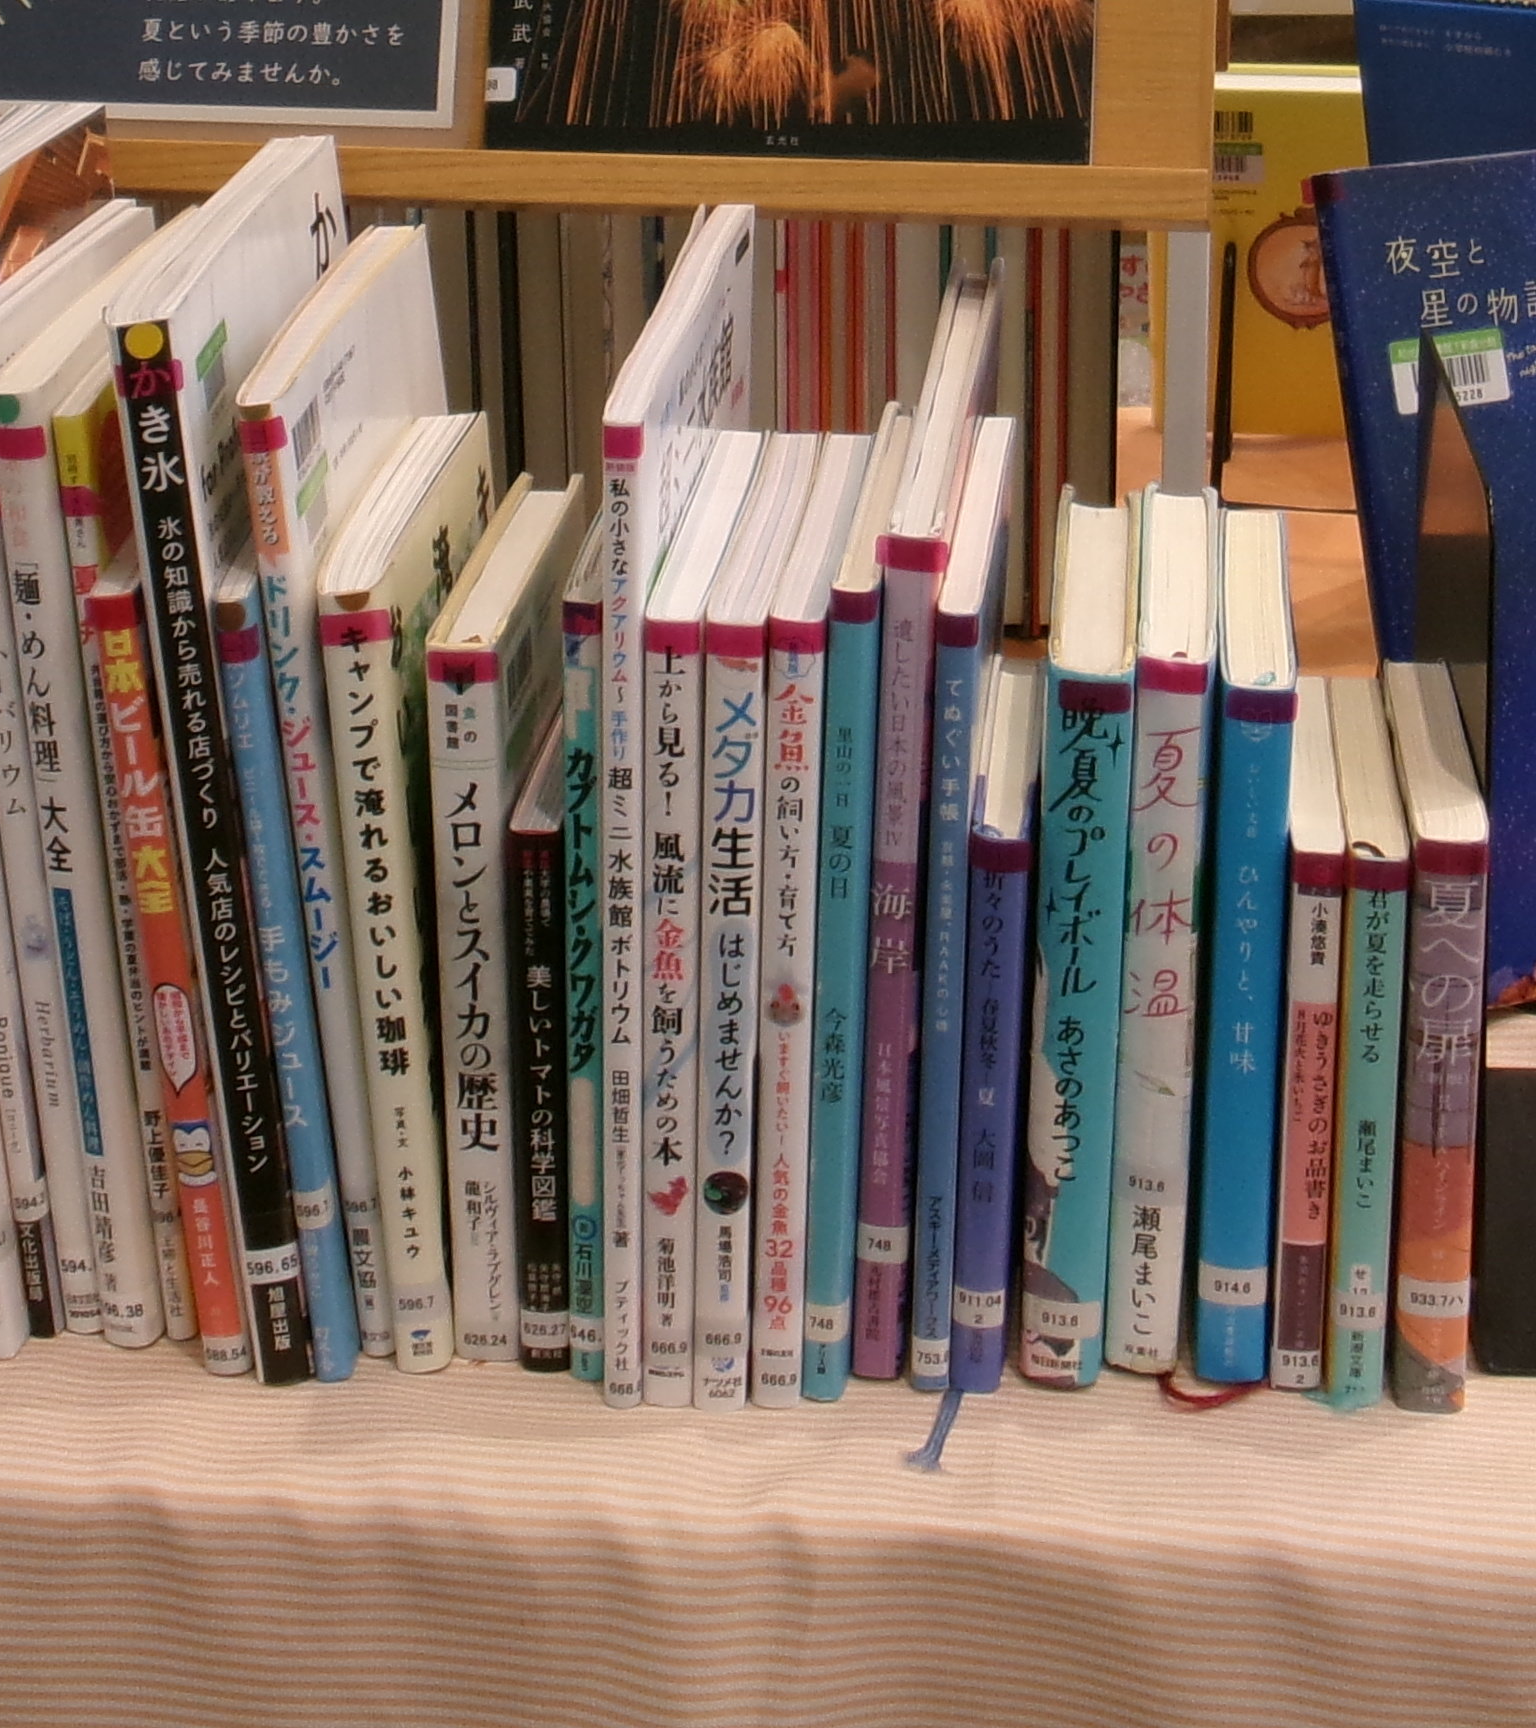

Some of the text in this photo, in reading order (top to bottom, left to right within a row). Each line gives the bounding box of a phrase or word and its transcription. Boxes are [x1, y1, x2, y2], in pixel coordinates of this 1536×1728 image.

[138, 59, 341, 85] 感じてみませんか。
[142, 19, 405, 46] 夏という季節の豊かさを
[1385, 236, 1485, 278] 夜空と
[131, 362, 183, 493] かき氷
[157, 519, 217, 830] 氷の知識から売れる店づくり
[203, 848, 267, 1174] 人気店のレシピとバリエーション
[707, 693, 757, 917] メダカ生活
[771, 683, 815, 957] 金魚の飼い方・育て方
[939, 680, 962, 821] てぬぐい手帳
[341, 626, 410, 1076] キャンプで淹れるおいしい珈琲
[1125, 727, 1202, 1017] 夏の体温
[444, 783, 501, 1152] メロンとスイカの歴史
[610, 936, 633, 1045] ボトリウム
[651, 832, 686, 1167] 風流に金魚を飼うための本
[820, 825, 853, 1104] 夏の日 今森光彦
[869, 884, 913, 975] 海岸
[1049, 702, 1109, 1181] 晩夏のプレイボール あさのあつこ
[1228, 865, 1261, 1074] ひんやりと、 甘味
[1419, 878, 1479, 1064] 夏への扉
[34, 1000, 59, 1108] Herbarium
[259, 927, 306, 1128] 手もみジュース
[524, 965, 558, 1221] 美しいトマトの科学図鑑
[1353, 888, 1387, 1210] 君が夏を走らせる 瀬尾まいこ
[1305, 1010, 1333, 1221] ゆきうさぎのお品書き
[191, 1198, 219, 1285] 長谷川正人
[247, 1255, 300, 1276] 596.65
[612, 1070, 631, 1371] 田畑哲生 ブティック社
[655, 1238, 677, 1308] 菊池洋明
[867, 1239, 892, 1251] 748
[1128, 1176, 1165, 1336] 913.6 瀬尾まいこ
[1212, 1279, 1251, 1294] 914.6
[464, 1332, 507, 1347] 626.24
[651, 1340, 688, 1355] 666.9
[704, 1332, 742, 1347] 666.9
[761, 1374, 797, 1388] 666.9
[809, 1318, 834, 1331] 748
[1340, 1303, 1376, 1318] 913.6
